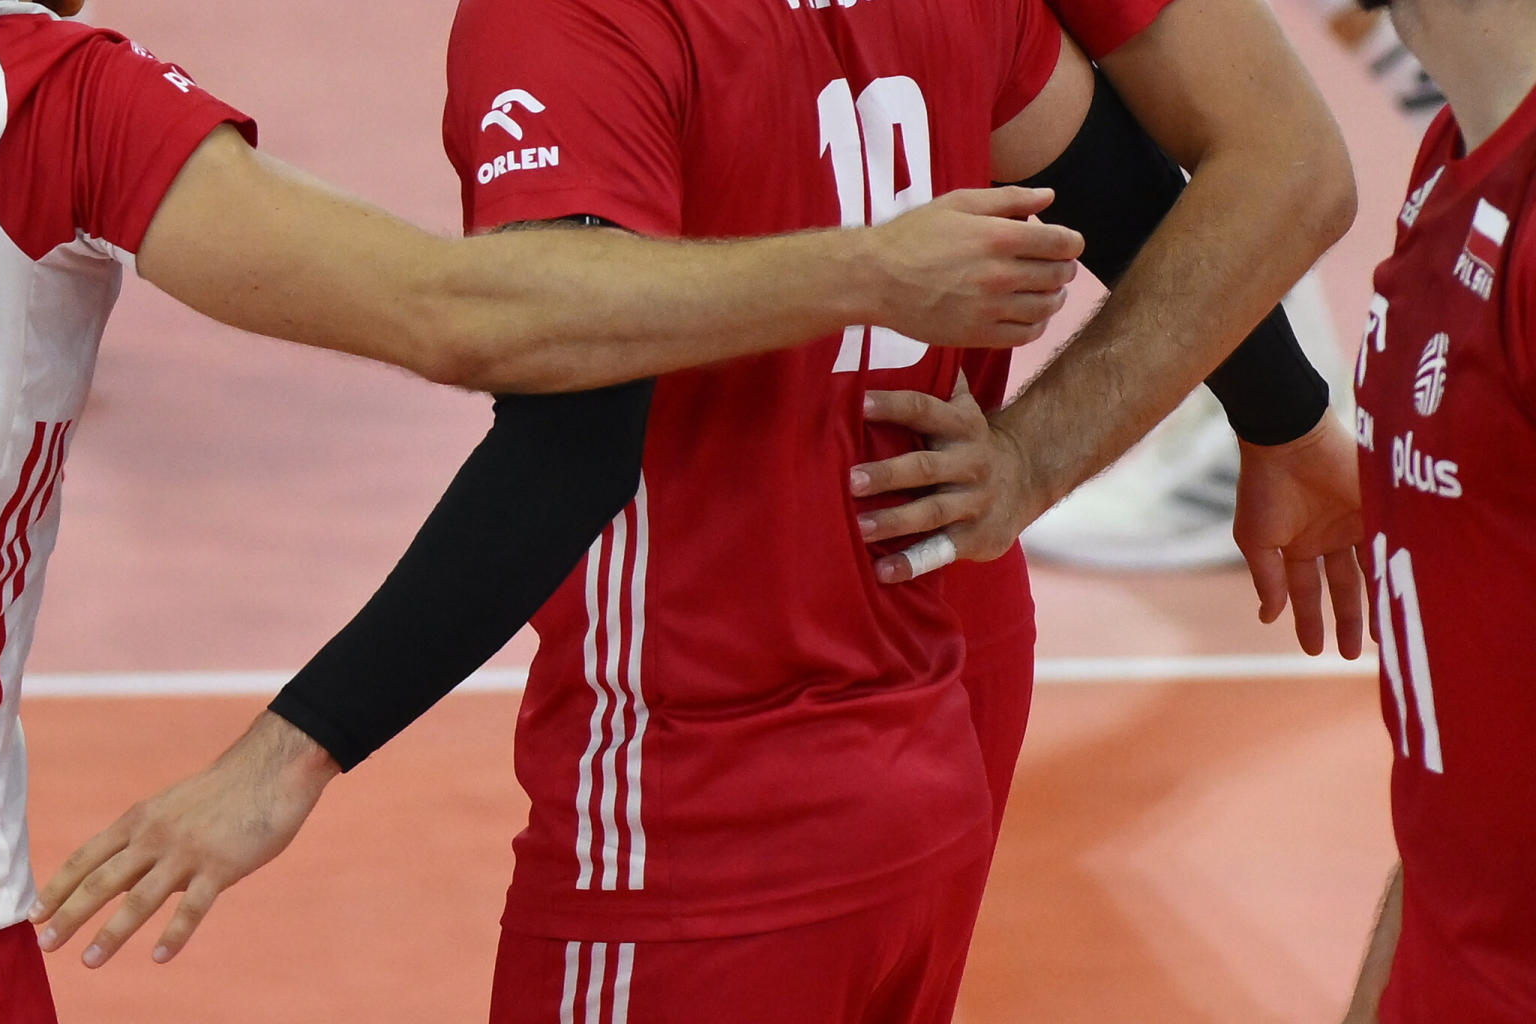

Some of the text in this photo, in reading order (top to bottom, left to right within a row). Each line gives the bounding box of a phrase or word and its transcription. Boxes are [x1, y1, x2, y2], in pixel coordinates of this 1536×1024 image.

[477, 145, 559, 185] ORLEN
[1392, 429, 1463, 498] plus
[1372, 530, 1444, 775] 11
